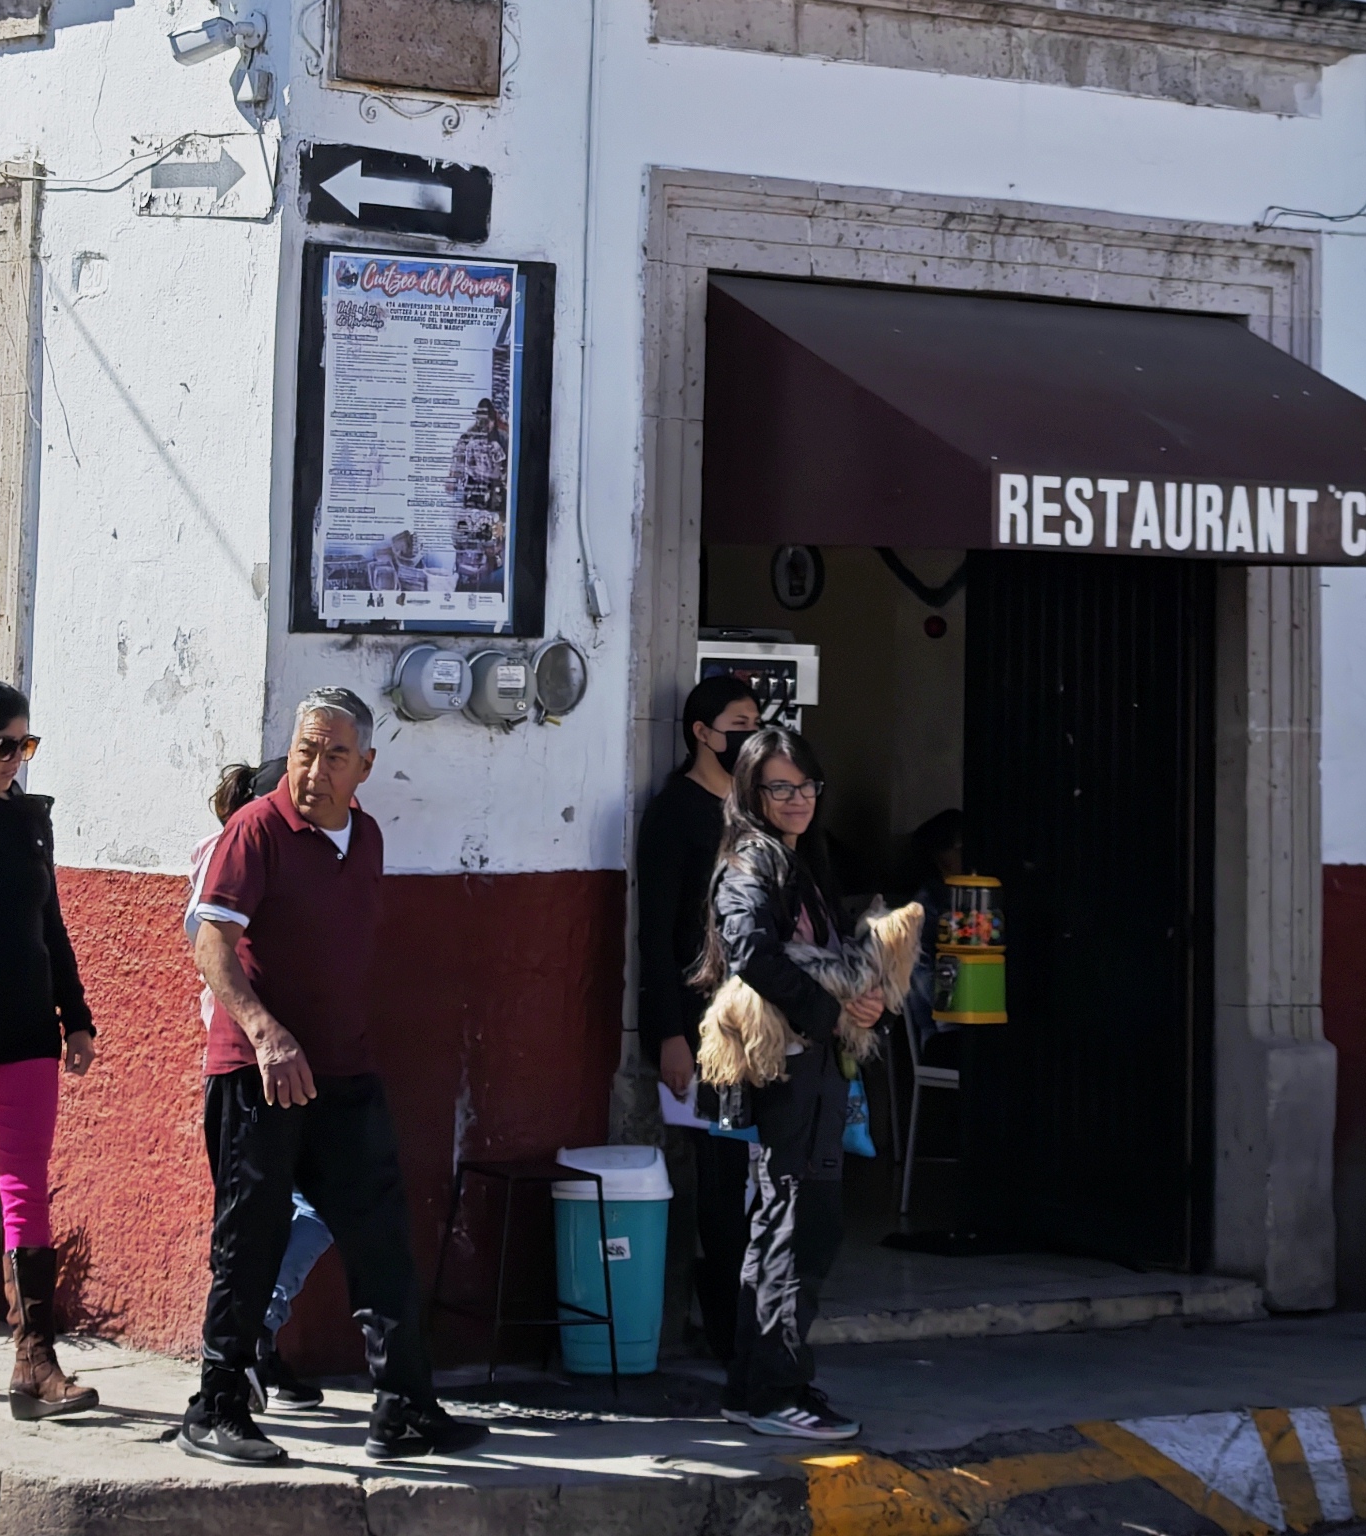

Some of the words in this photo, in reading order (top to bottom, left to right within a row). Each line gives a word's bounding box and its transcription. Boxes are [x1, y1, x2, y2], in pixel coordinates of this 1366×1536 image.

[363, 262, 417, 296] Cuitzeo
[420, 266, 449, 295] del
[450, 268, 509, 297] Porvenir
[998, 473, 1319, 555] RESTAURANT
